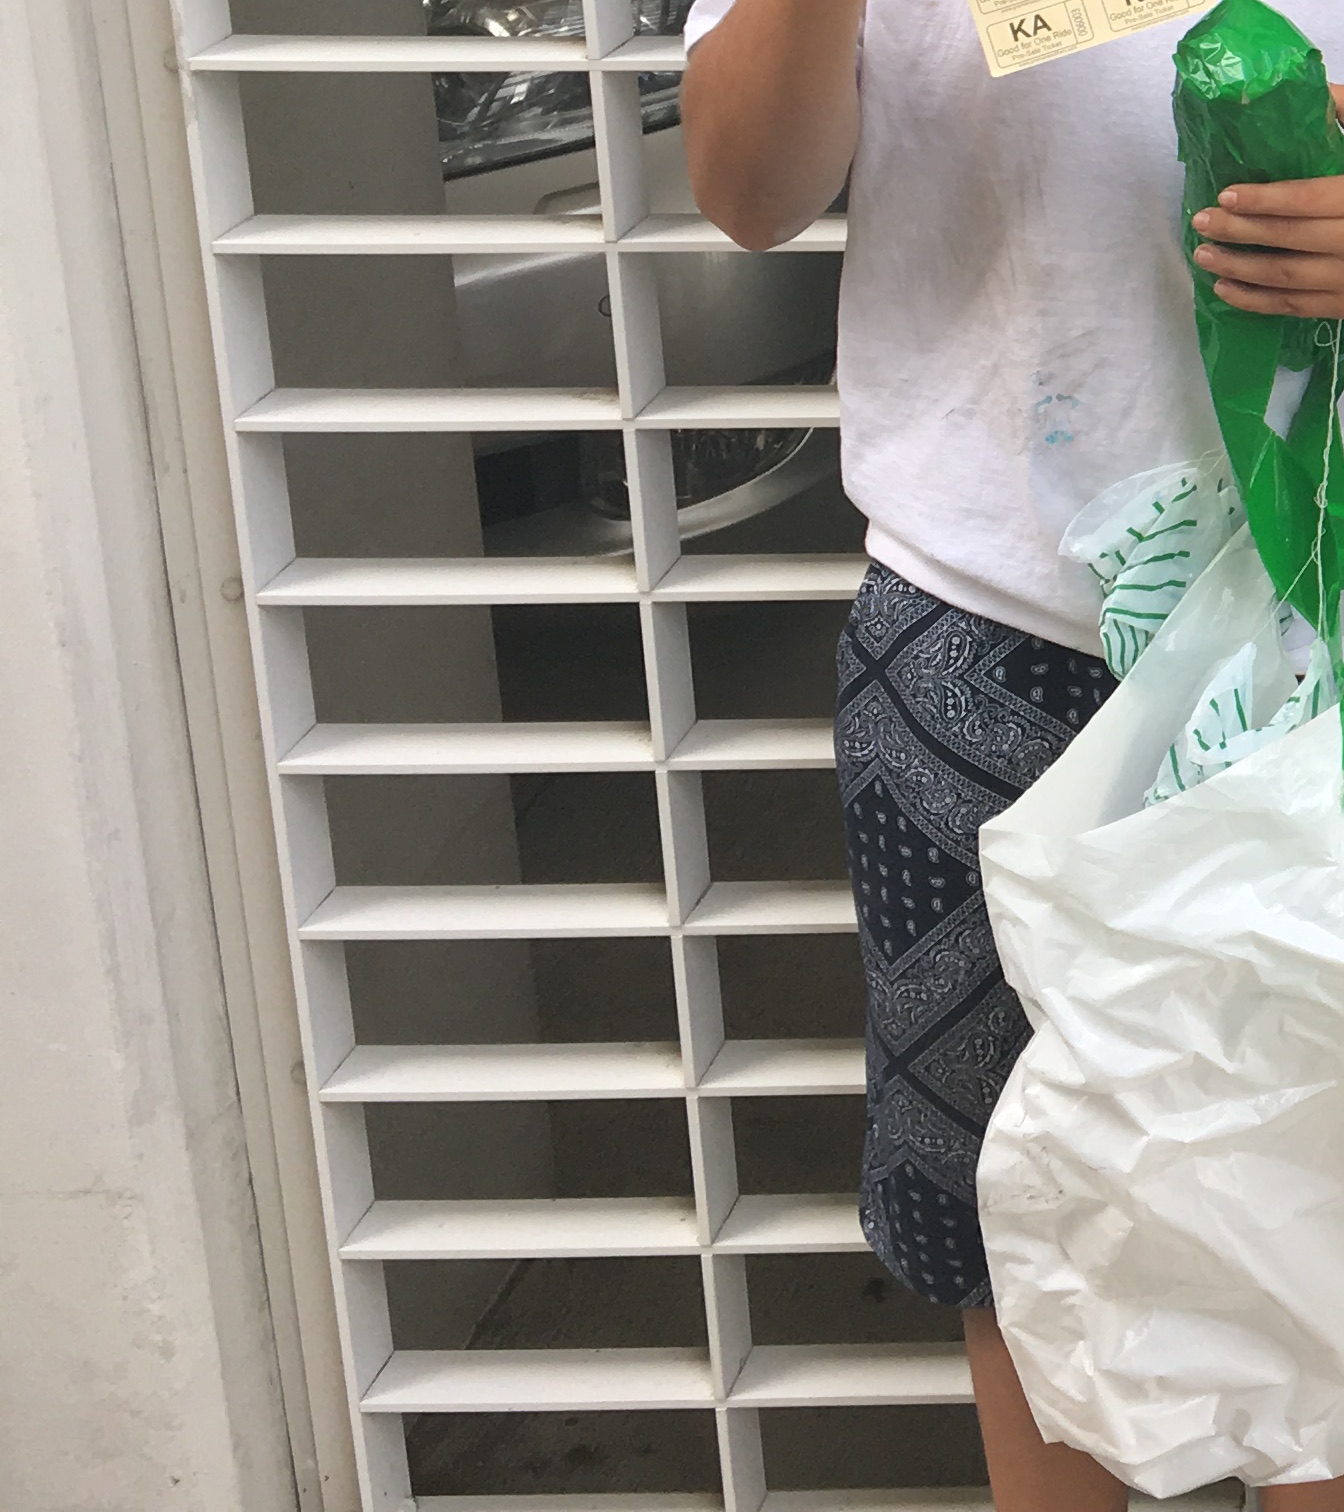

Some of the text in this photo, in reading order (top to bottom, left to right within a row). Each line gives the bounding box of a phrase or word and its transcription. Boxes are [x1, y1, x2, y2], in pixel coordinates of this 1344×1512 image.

[1109, 8, 1133, 22] Good
[1132, 5, 1144, 14] for
[1145, 0, 1164, 10] One
[1008, 14, 1053, 42] KA
[996, 28, 1072, 58] Good for One Ride
